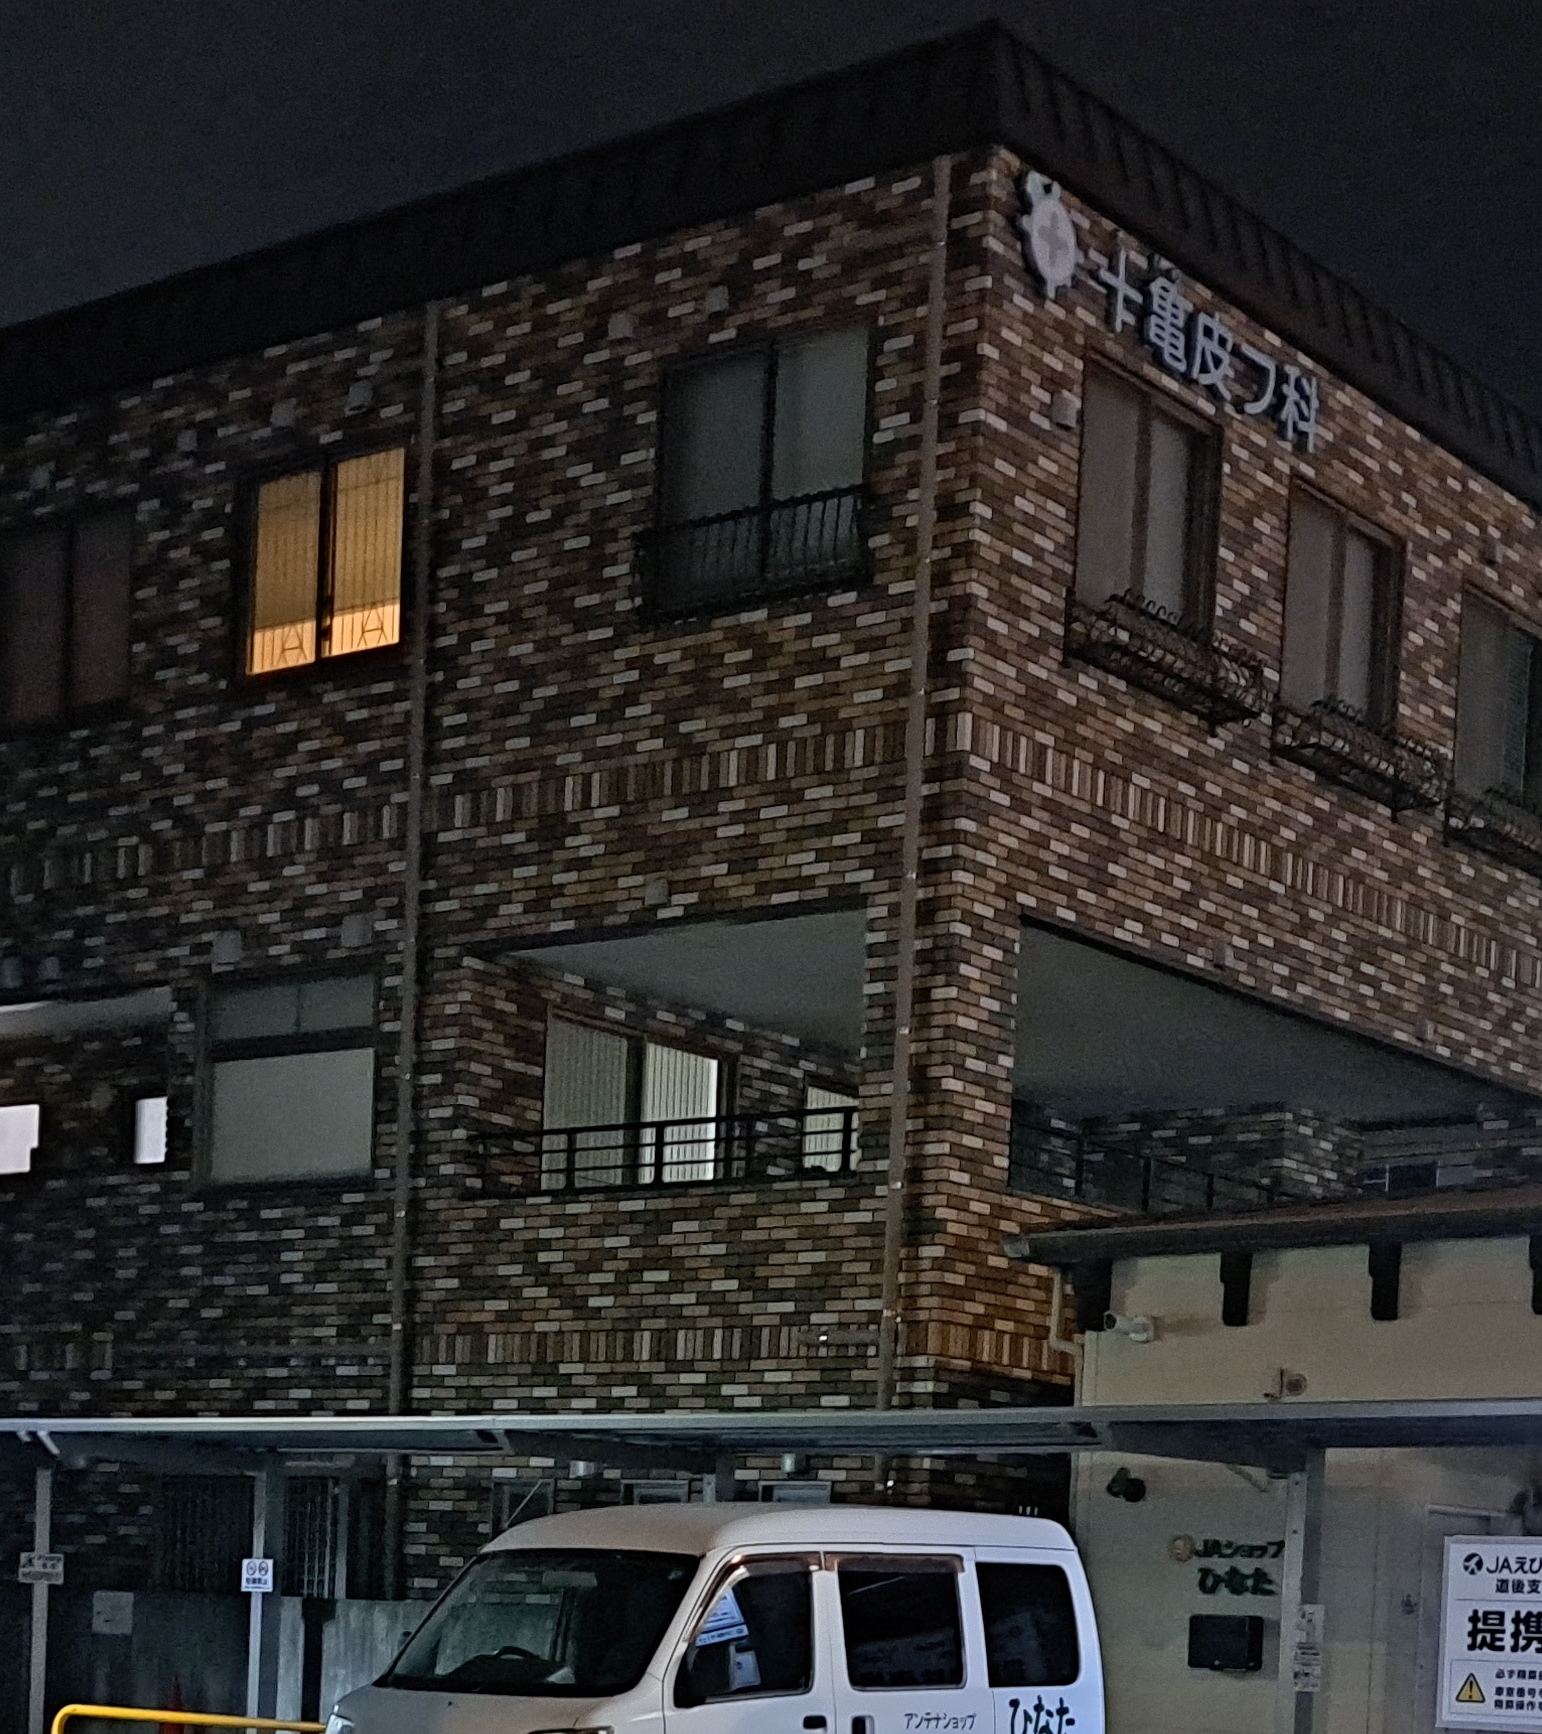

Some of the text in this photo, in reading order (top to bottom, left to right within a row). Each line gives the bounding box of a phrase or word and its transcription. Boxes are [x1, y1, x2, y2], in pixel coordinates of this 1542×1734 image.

[904, 1712, 977, 1730] アンテナショップ
